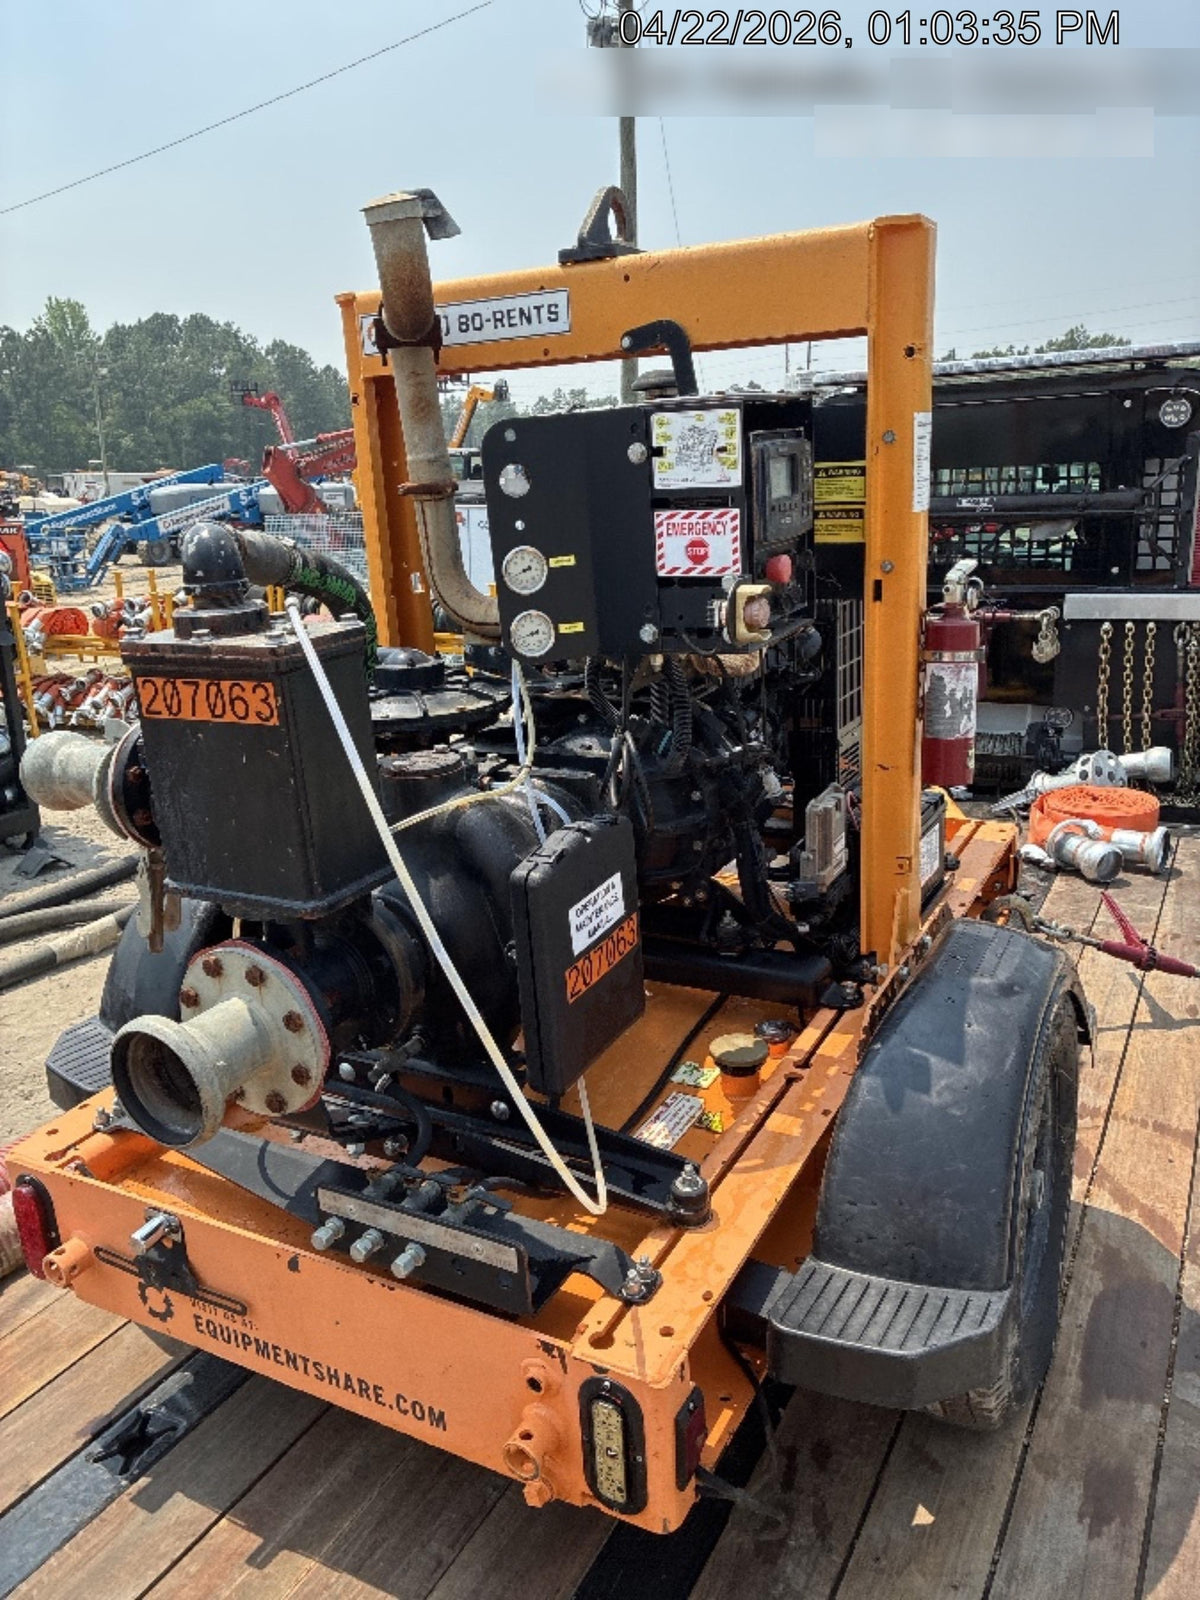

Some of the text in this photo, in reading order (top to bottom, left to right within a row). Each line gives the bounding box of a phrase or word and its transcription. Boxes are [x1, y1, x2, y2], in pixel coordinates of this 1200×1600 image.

[666, 521, 728, 537] EMERGENCY
[687, 546, 710, 556] STOP
[141, 678, 275, 722] 207063
[568, 916, 636, 999] 207063
[193, 1313, 447, 1431] EQUIPMENTSHARE.COM
